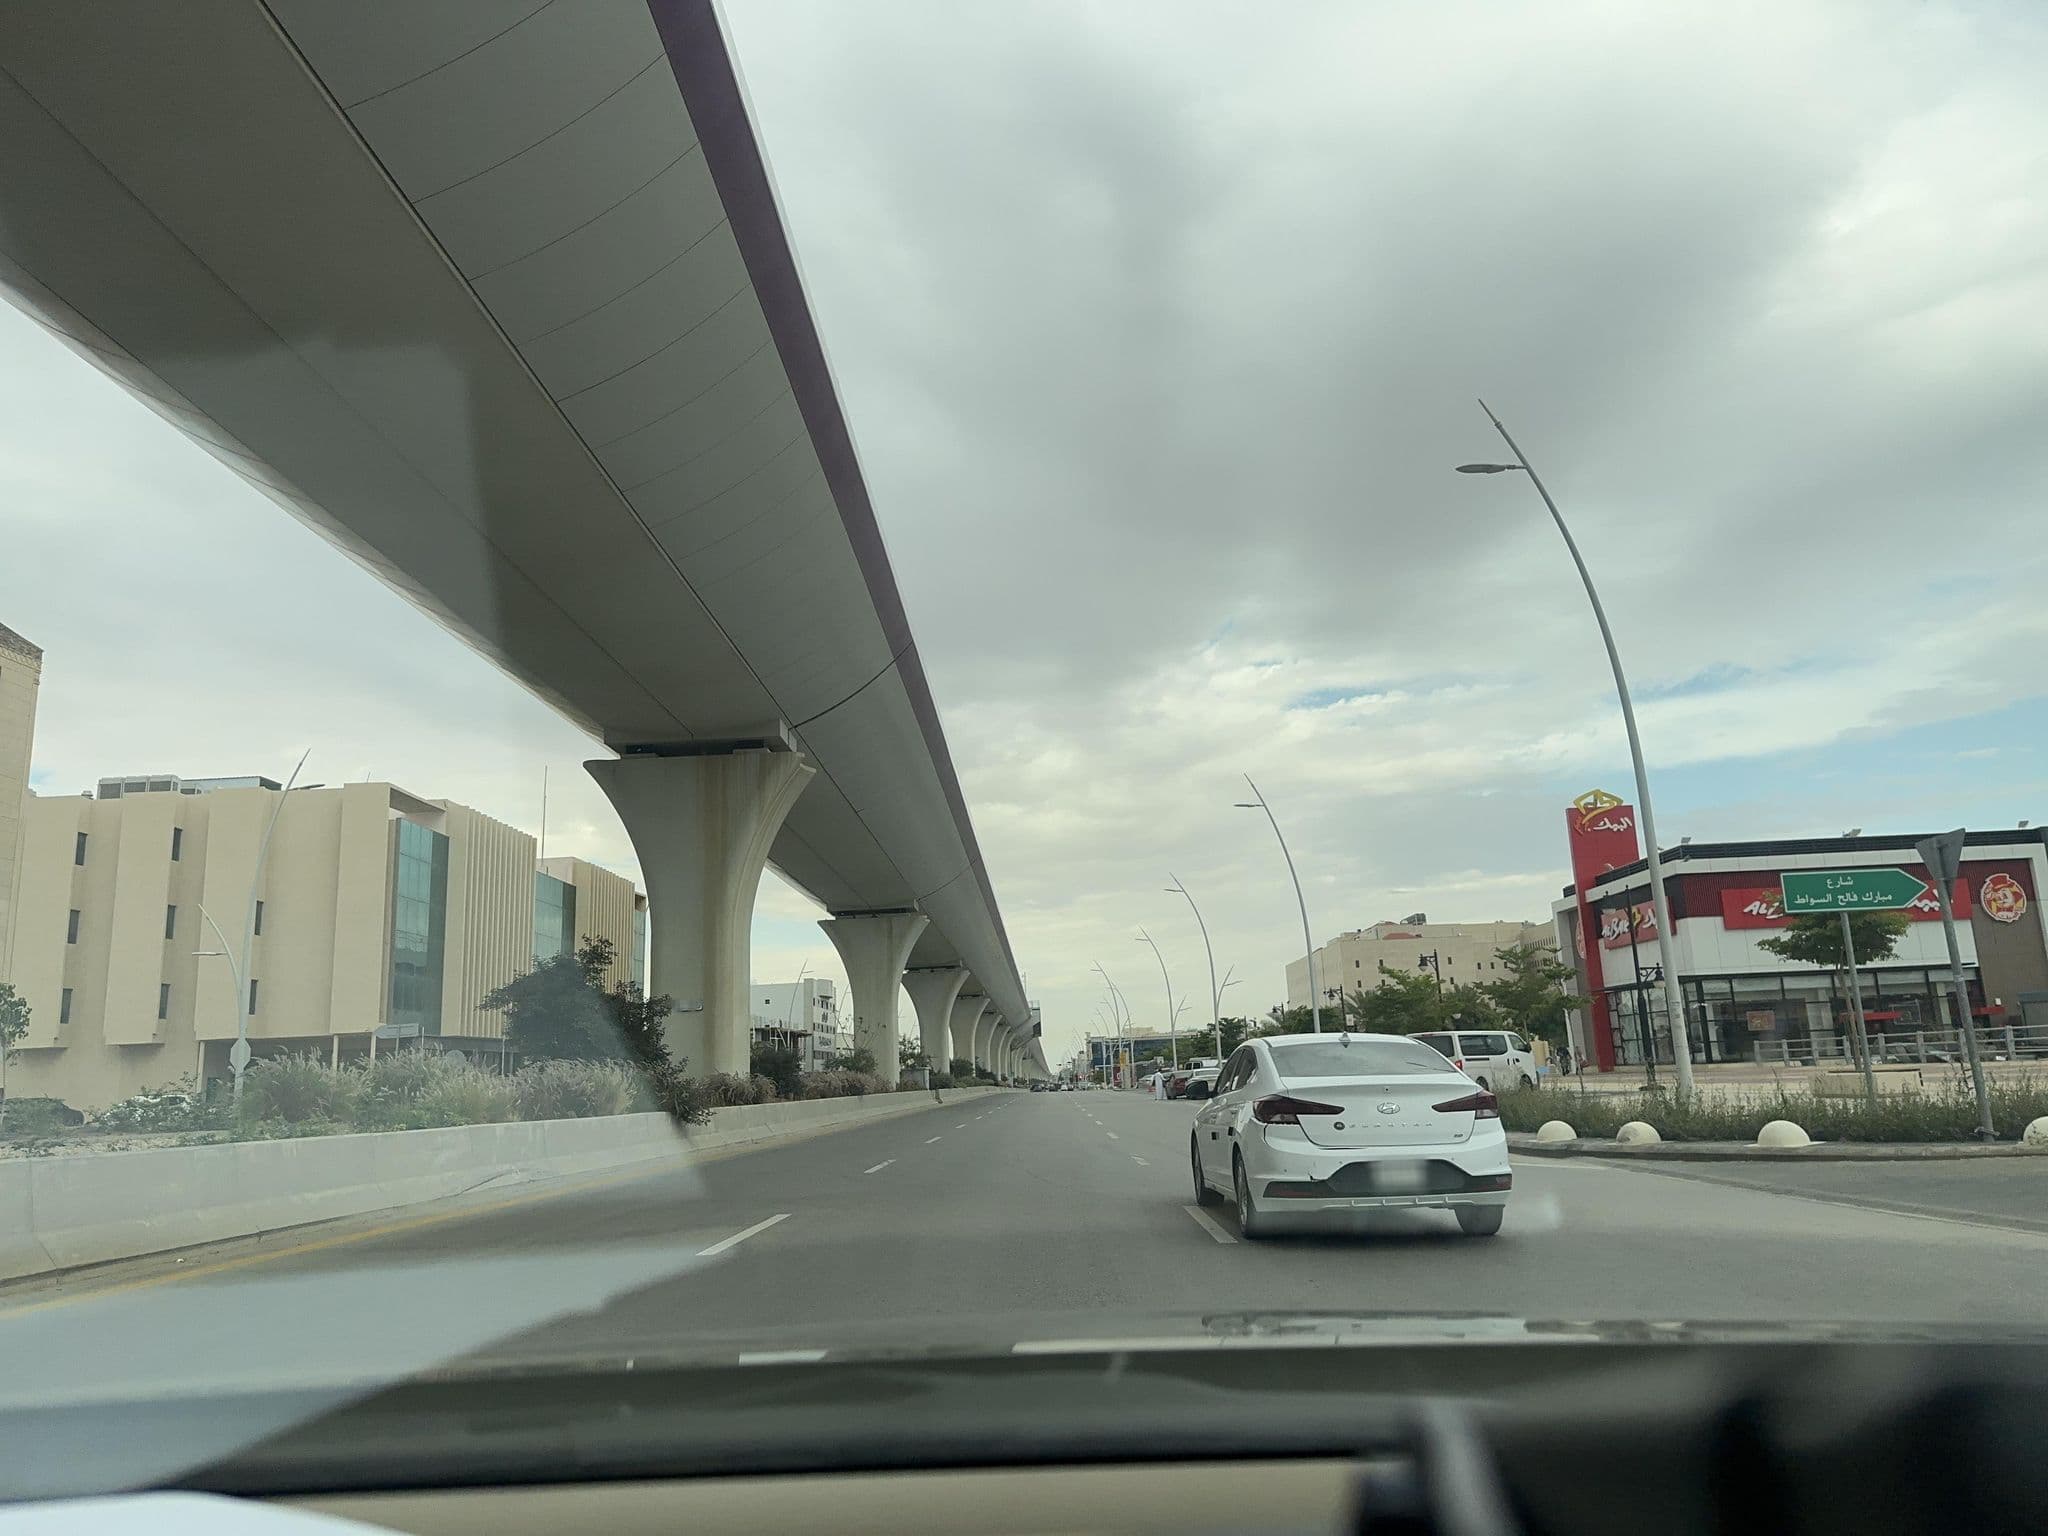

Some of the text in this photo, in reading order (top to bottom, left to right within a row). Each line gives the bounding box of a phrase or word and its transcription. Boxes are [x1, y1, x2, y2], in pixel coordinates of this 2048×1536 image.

[1593, 817, 1632, 832] البيك
[1826, 876, 1853, 888] شارع
[1794, 893, 1832, 906] السواط
[1837, 891, 1858, 905] فالح
[1861, 890, 1892, 903] مبارك
